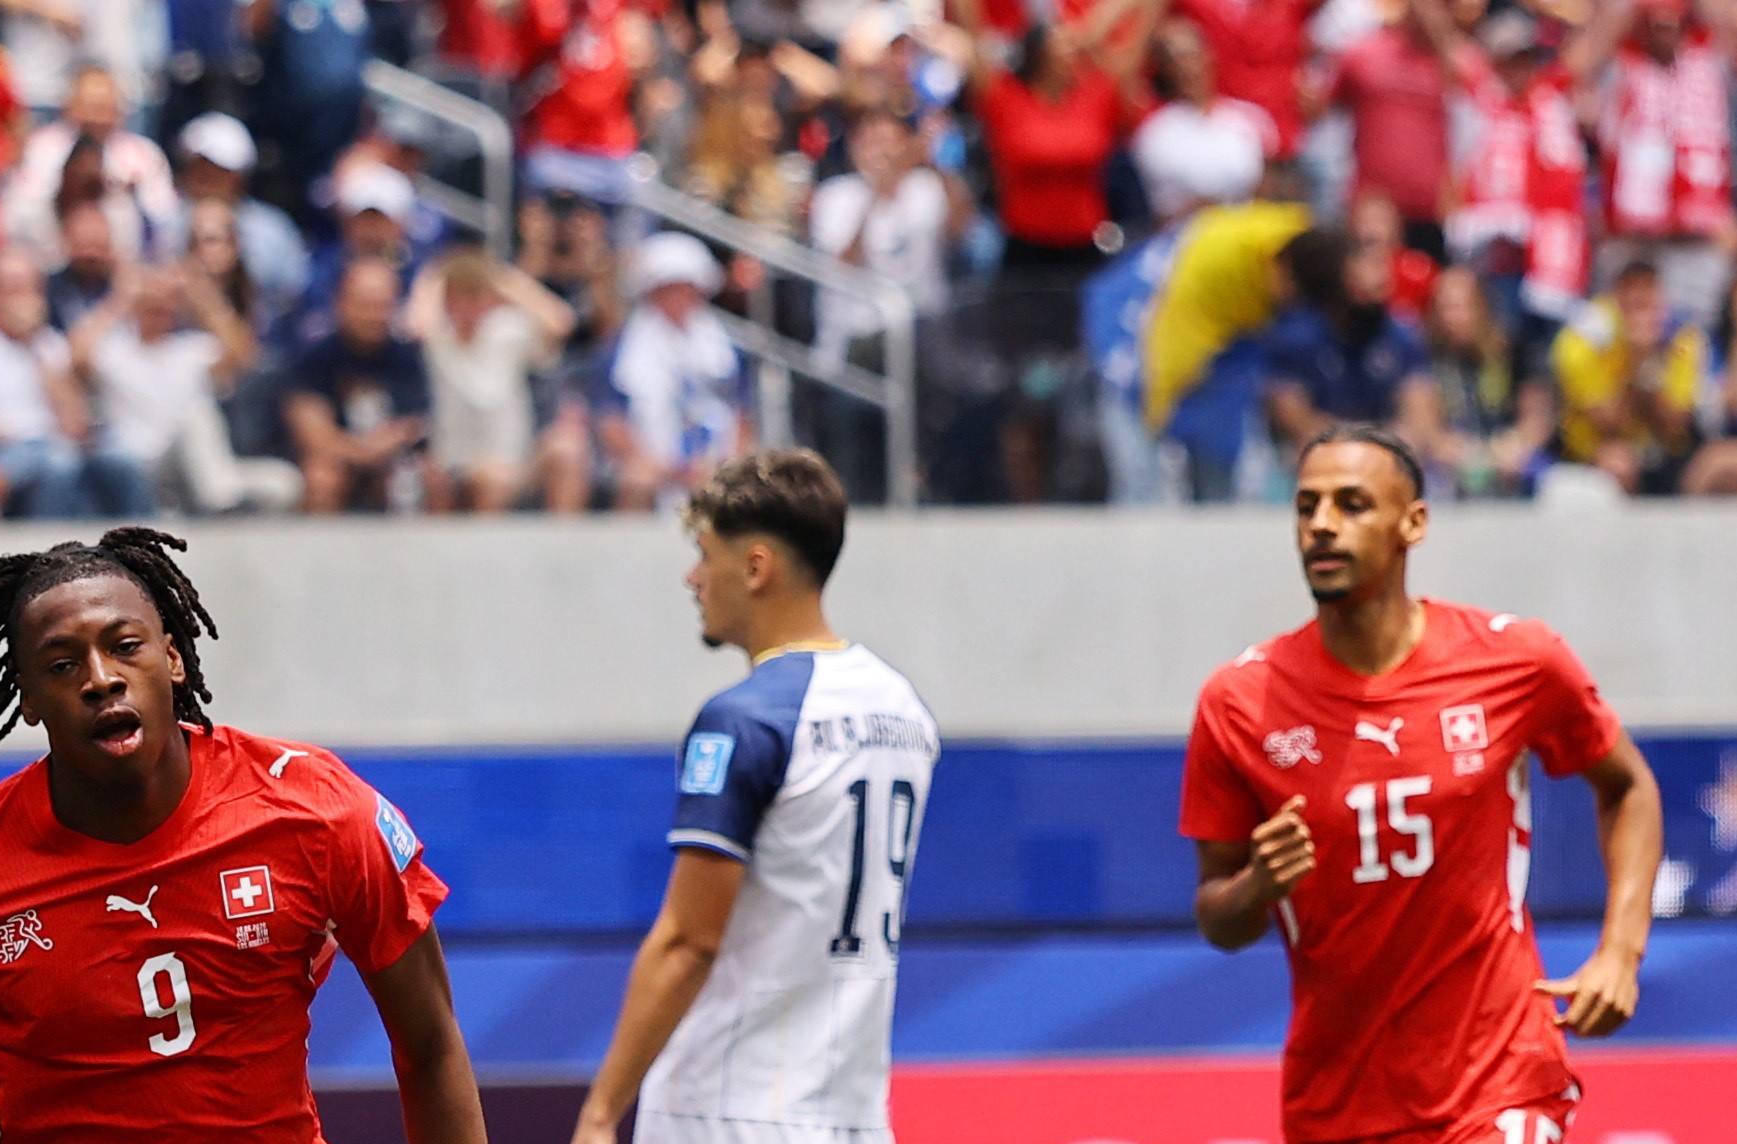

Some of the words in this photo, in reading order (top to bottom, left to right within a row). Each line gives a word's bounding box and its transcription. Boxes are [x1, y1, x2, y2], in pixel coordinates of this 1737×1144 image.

[830, 779, 915, 958] 19
[1344, 774, 1435, 884] 15
[136, 950, 197, 1057] 9
